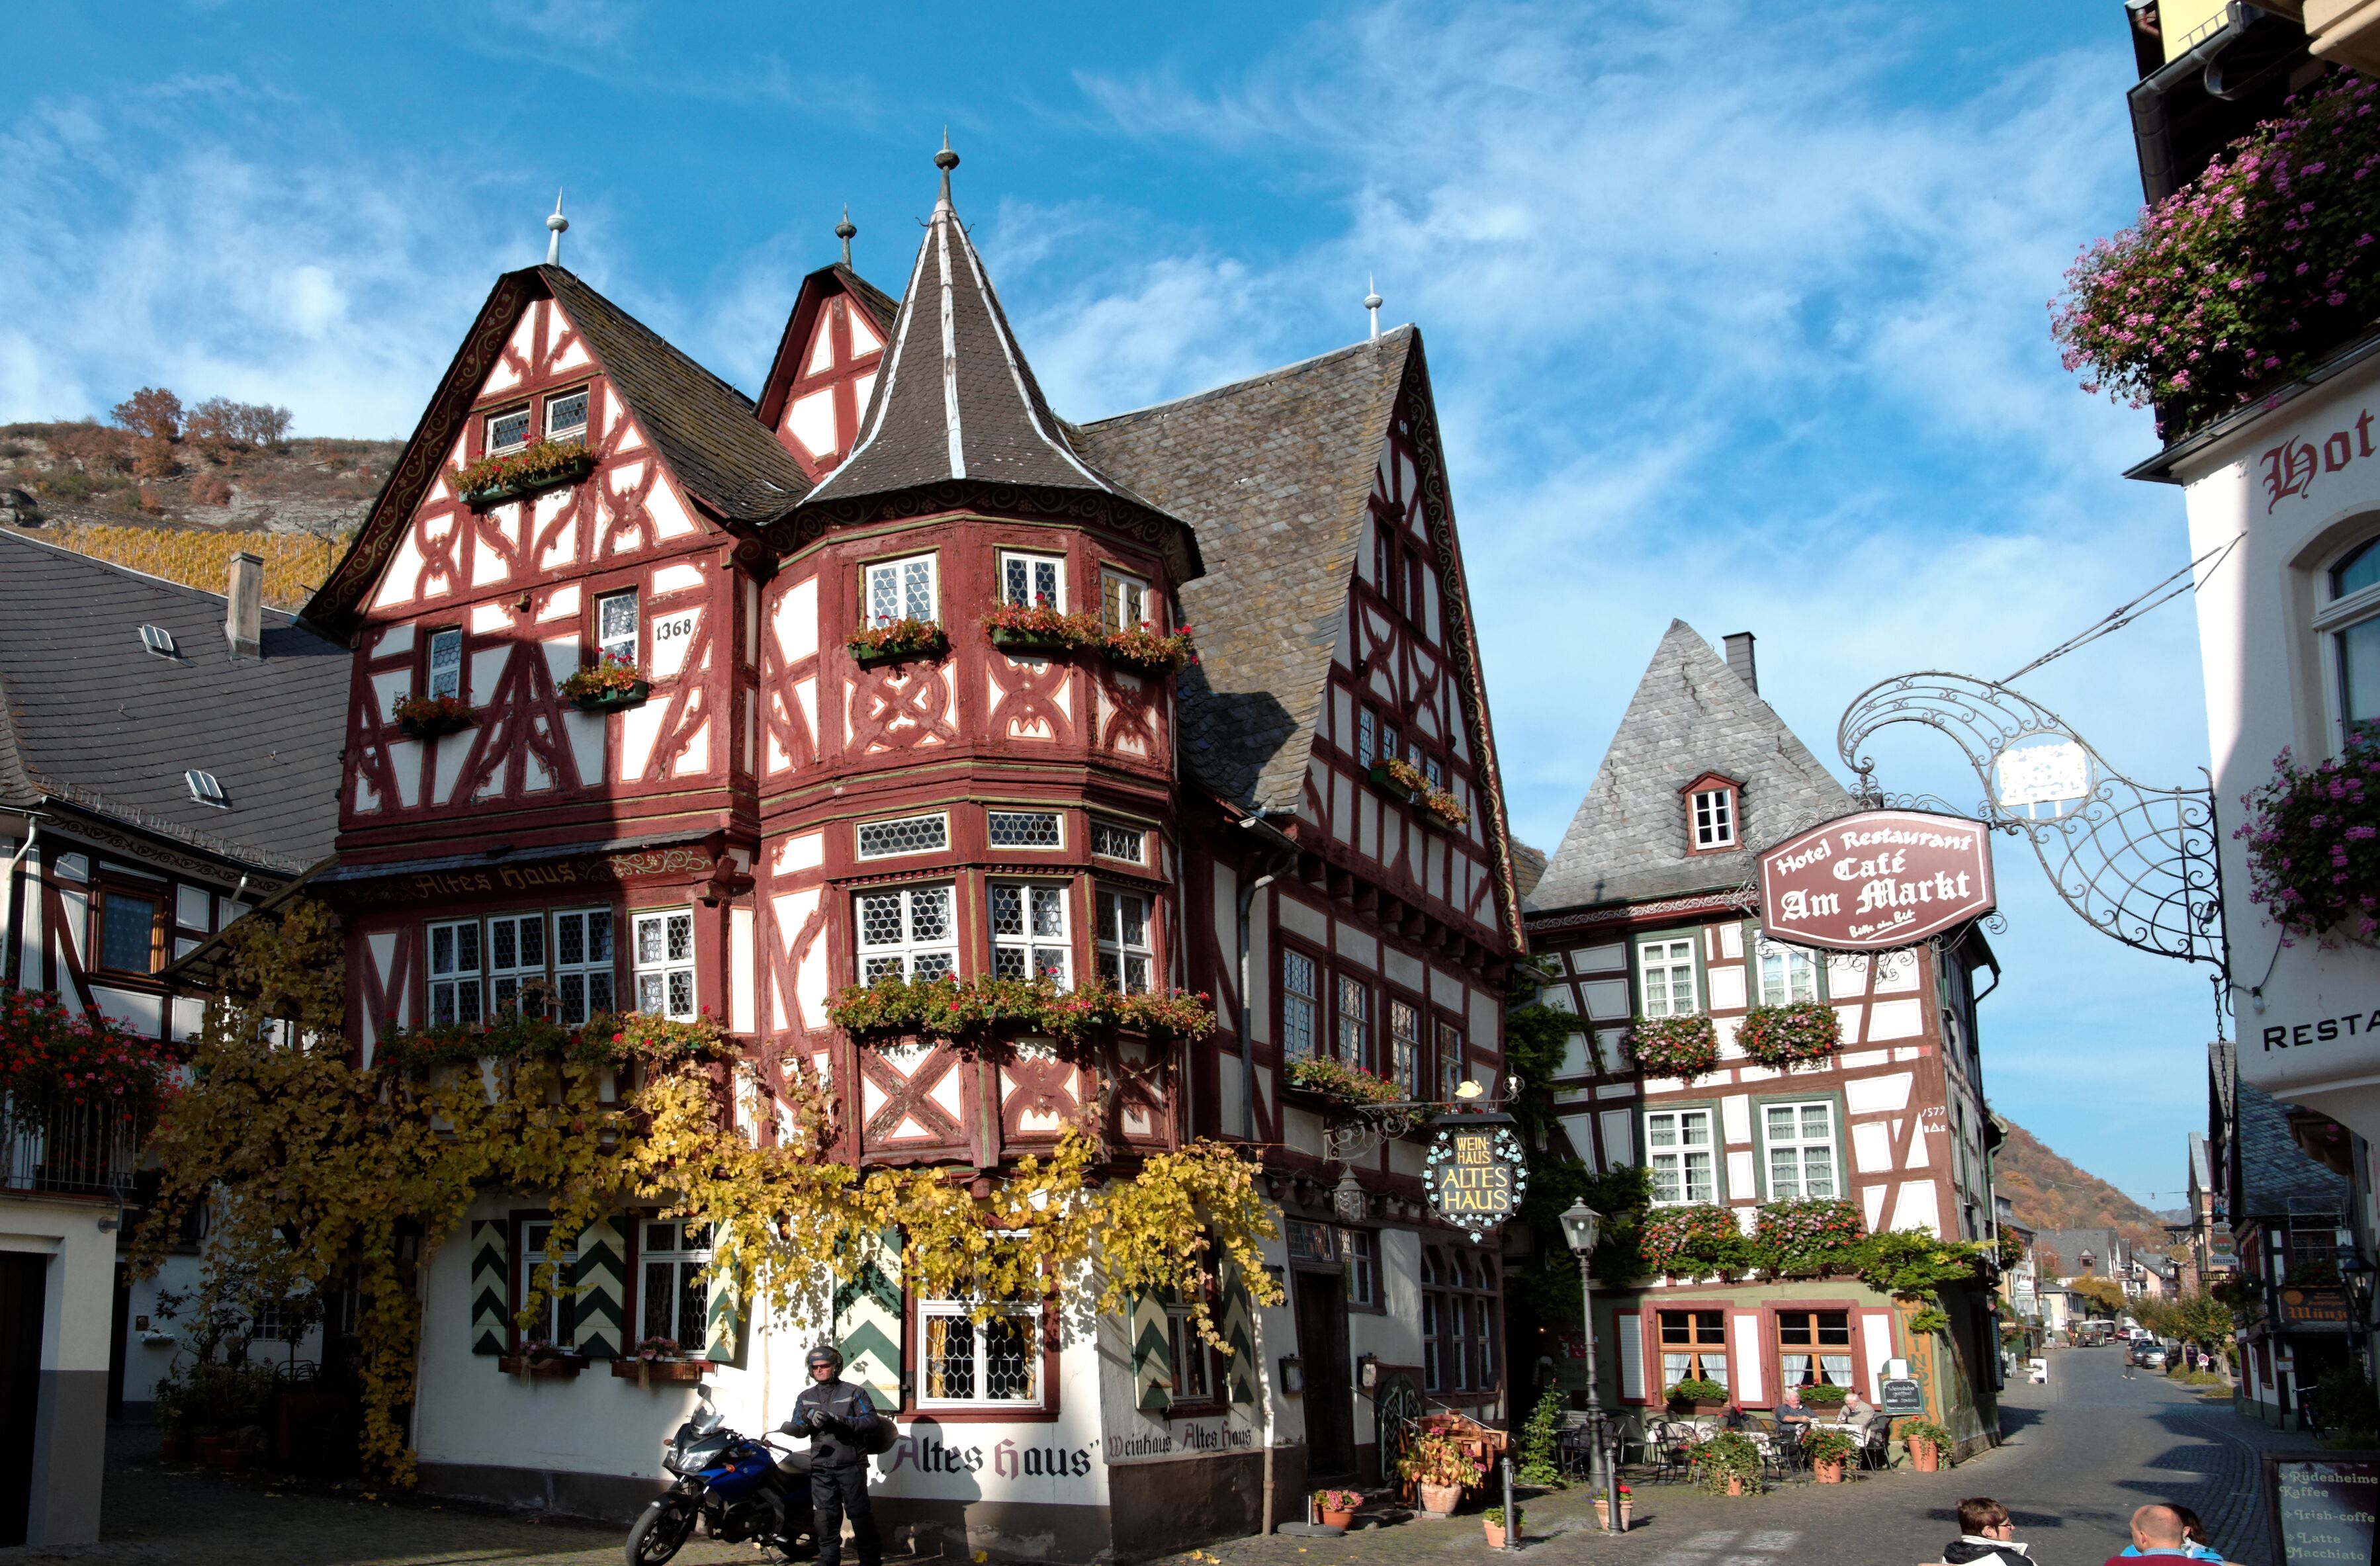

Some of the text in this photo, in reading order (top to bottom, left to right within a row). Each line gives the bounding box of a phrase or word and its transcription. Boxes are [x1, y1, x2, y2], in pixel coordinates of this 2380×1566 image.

[2260, 408, 2377, 515] Hot
[656, 619, 691, 640] 1368
[1776, 827, 1972, 877] Hotel Restaurant
[1833, 849, 1906, 881] Café
[412, 863, 577, 898] Altes Haus
[1781, 870, 1971, 922] Am Markt
[1894, 909, 1915, 923] Bit
[2264, 1010, 2380, 1052] RESTA
[1921, 1106, 1945, 1117] 1579
[1456, 1137, 1490, 1151] WEIN-
[1458, 1151, 1491, 1164] HAUS
[1441, 1167, 1508, 1188] ALTES
[1444, 1190, 1508, 1210] HAUS
[1108, 1433, 1172, 1458] Weinhaus
[2289, 1471, 2379, 1485] Rüdesheime
[2279, 1485, 2329, 1499] Kaffee
[2294, 1509, 2375, 1523] Irish-coffe
[2297, 1532, 2341, 1544] Latte
[2286, 1546, 2365, 1561] Macchiato
